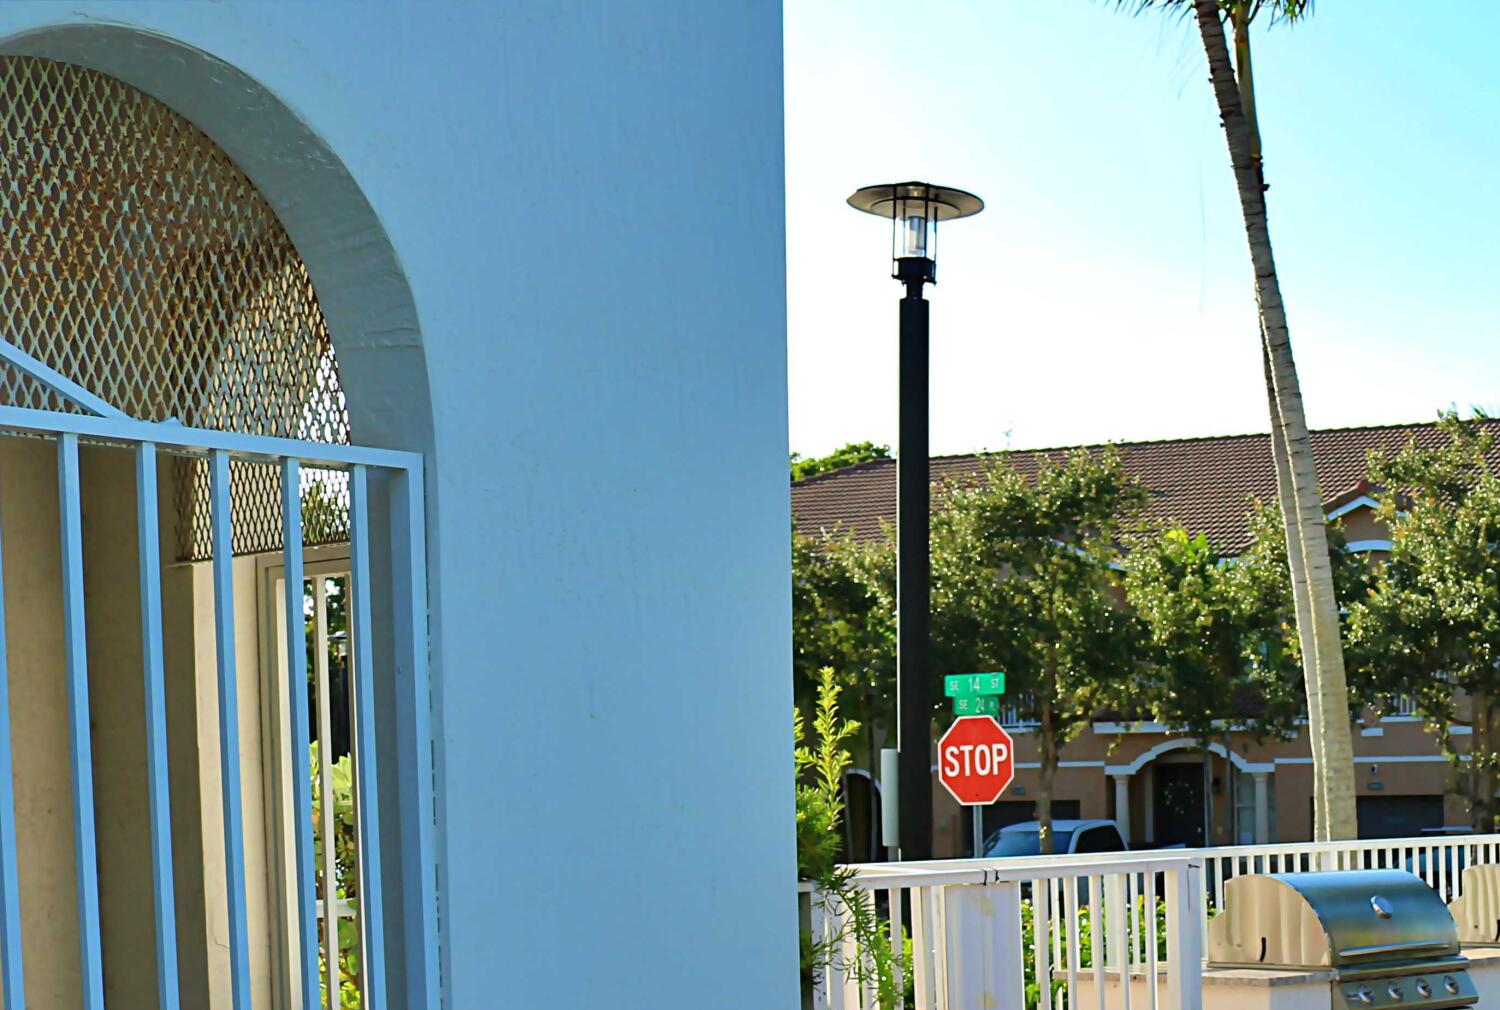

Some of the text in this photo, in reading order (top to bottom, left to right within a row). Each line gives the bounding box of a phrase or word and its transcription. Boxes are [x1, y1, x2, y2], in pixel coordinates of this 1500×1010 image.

[969, 676, 981, 692] 14
[976, 697, 985, 713] 24
[944, 743, 1008, 778] STOP
